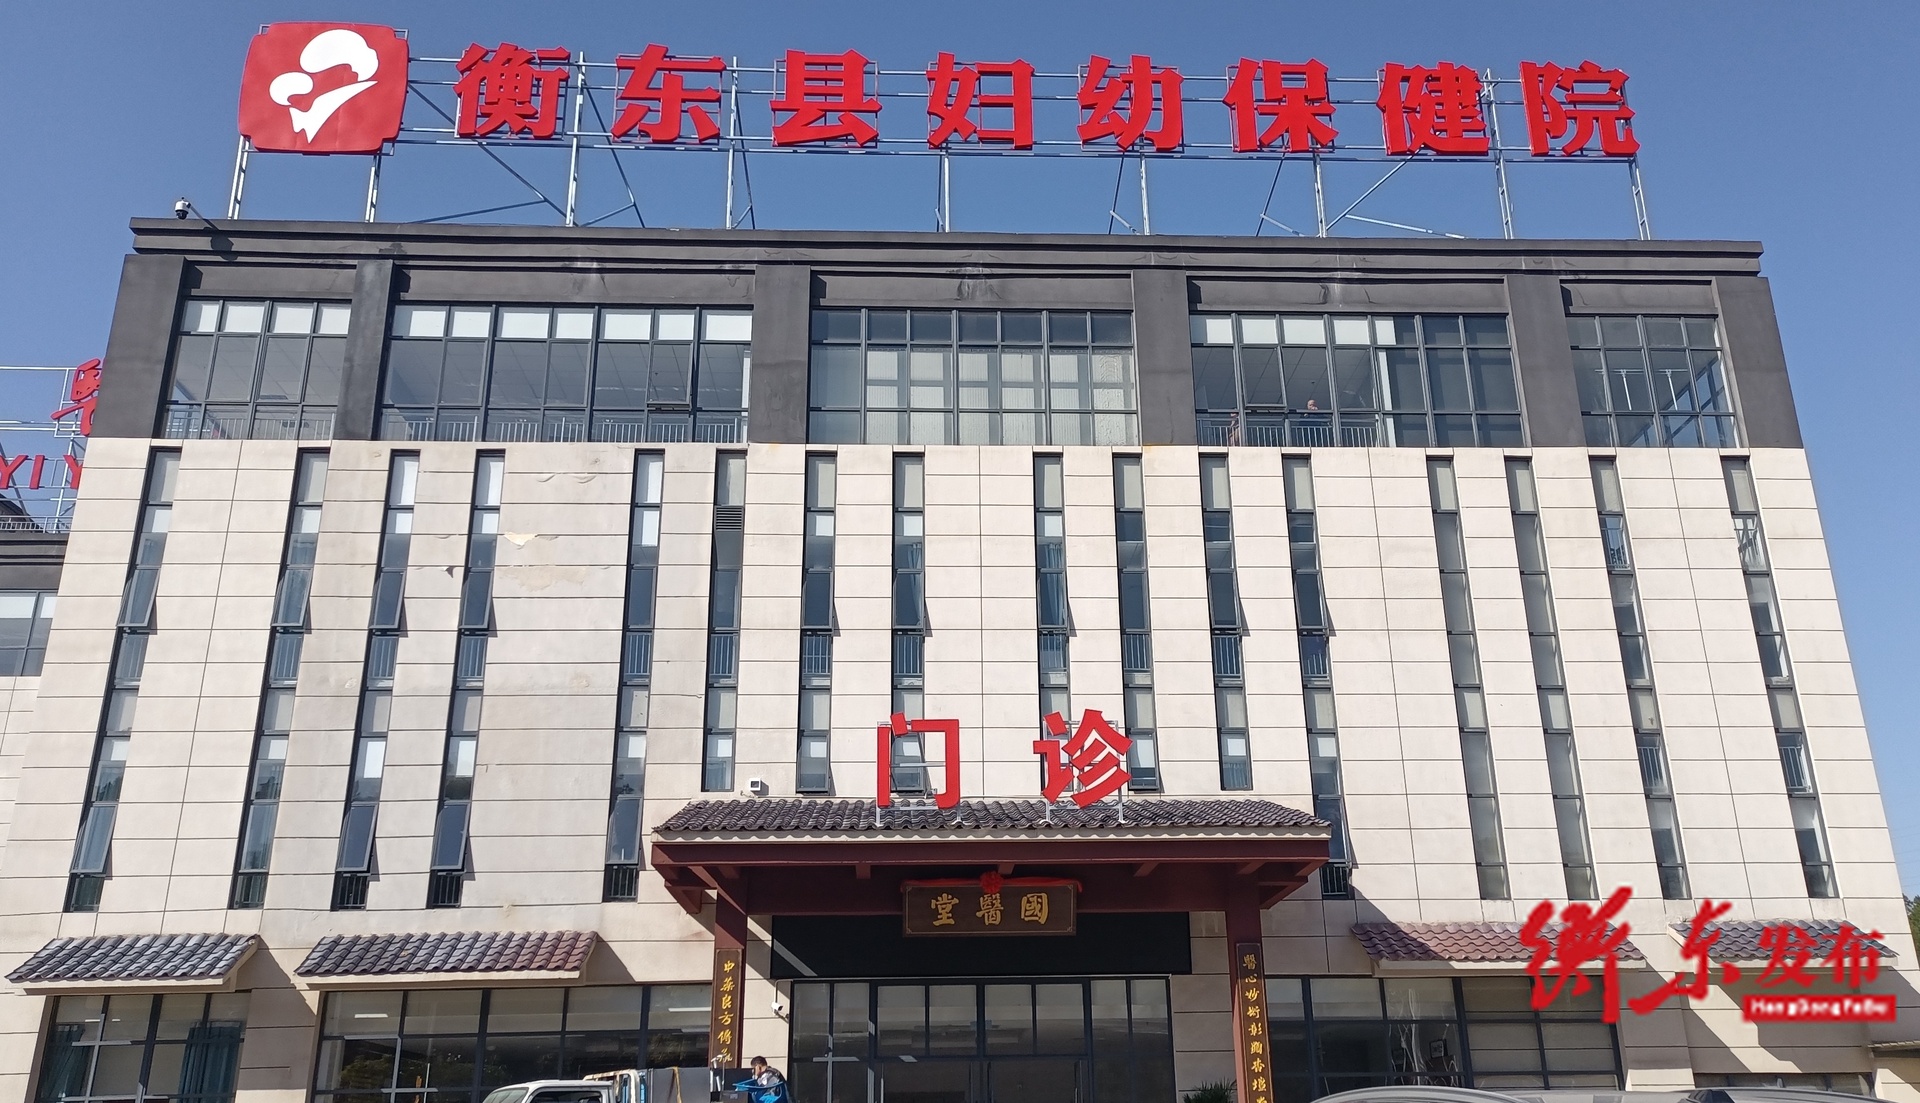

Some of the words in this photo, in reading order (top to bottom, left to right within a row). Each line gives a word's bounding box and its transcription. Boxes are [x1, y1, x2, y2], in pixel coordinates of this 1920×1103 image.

[454, 42, 1640, 158] 衡东县妇幼保健院
[877, 709, 1133, 810] 门诊
